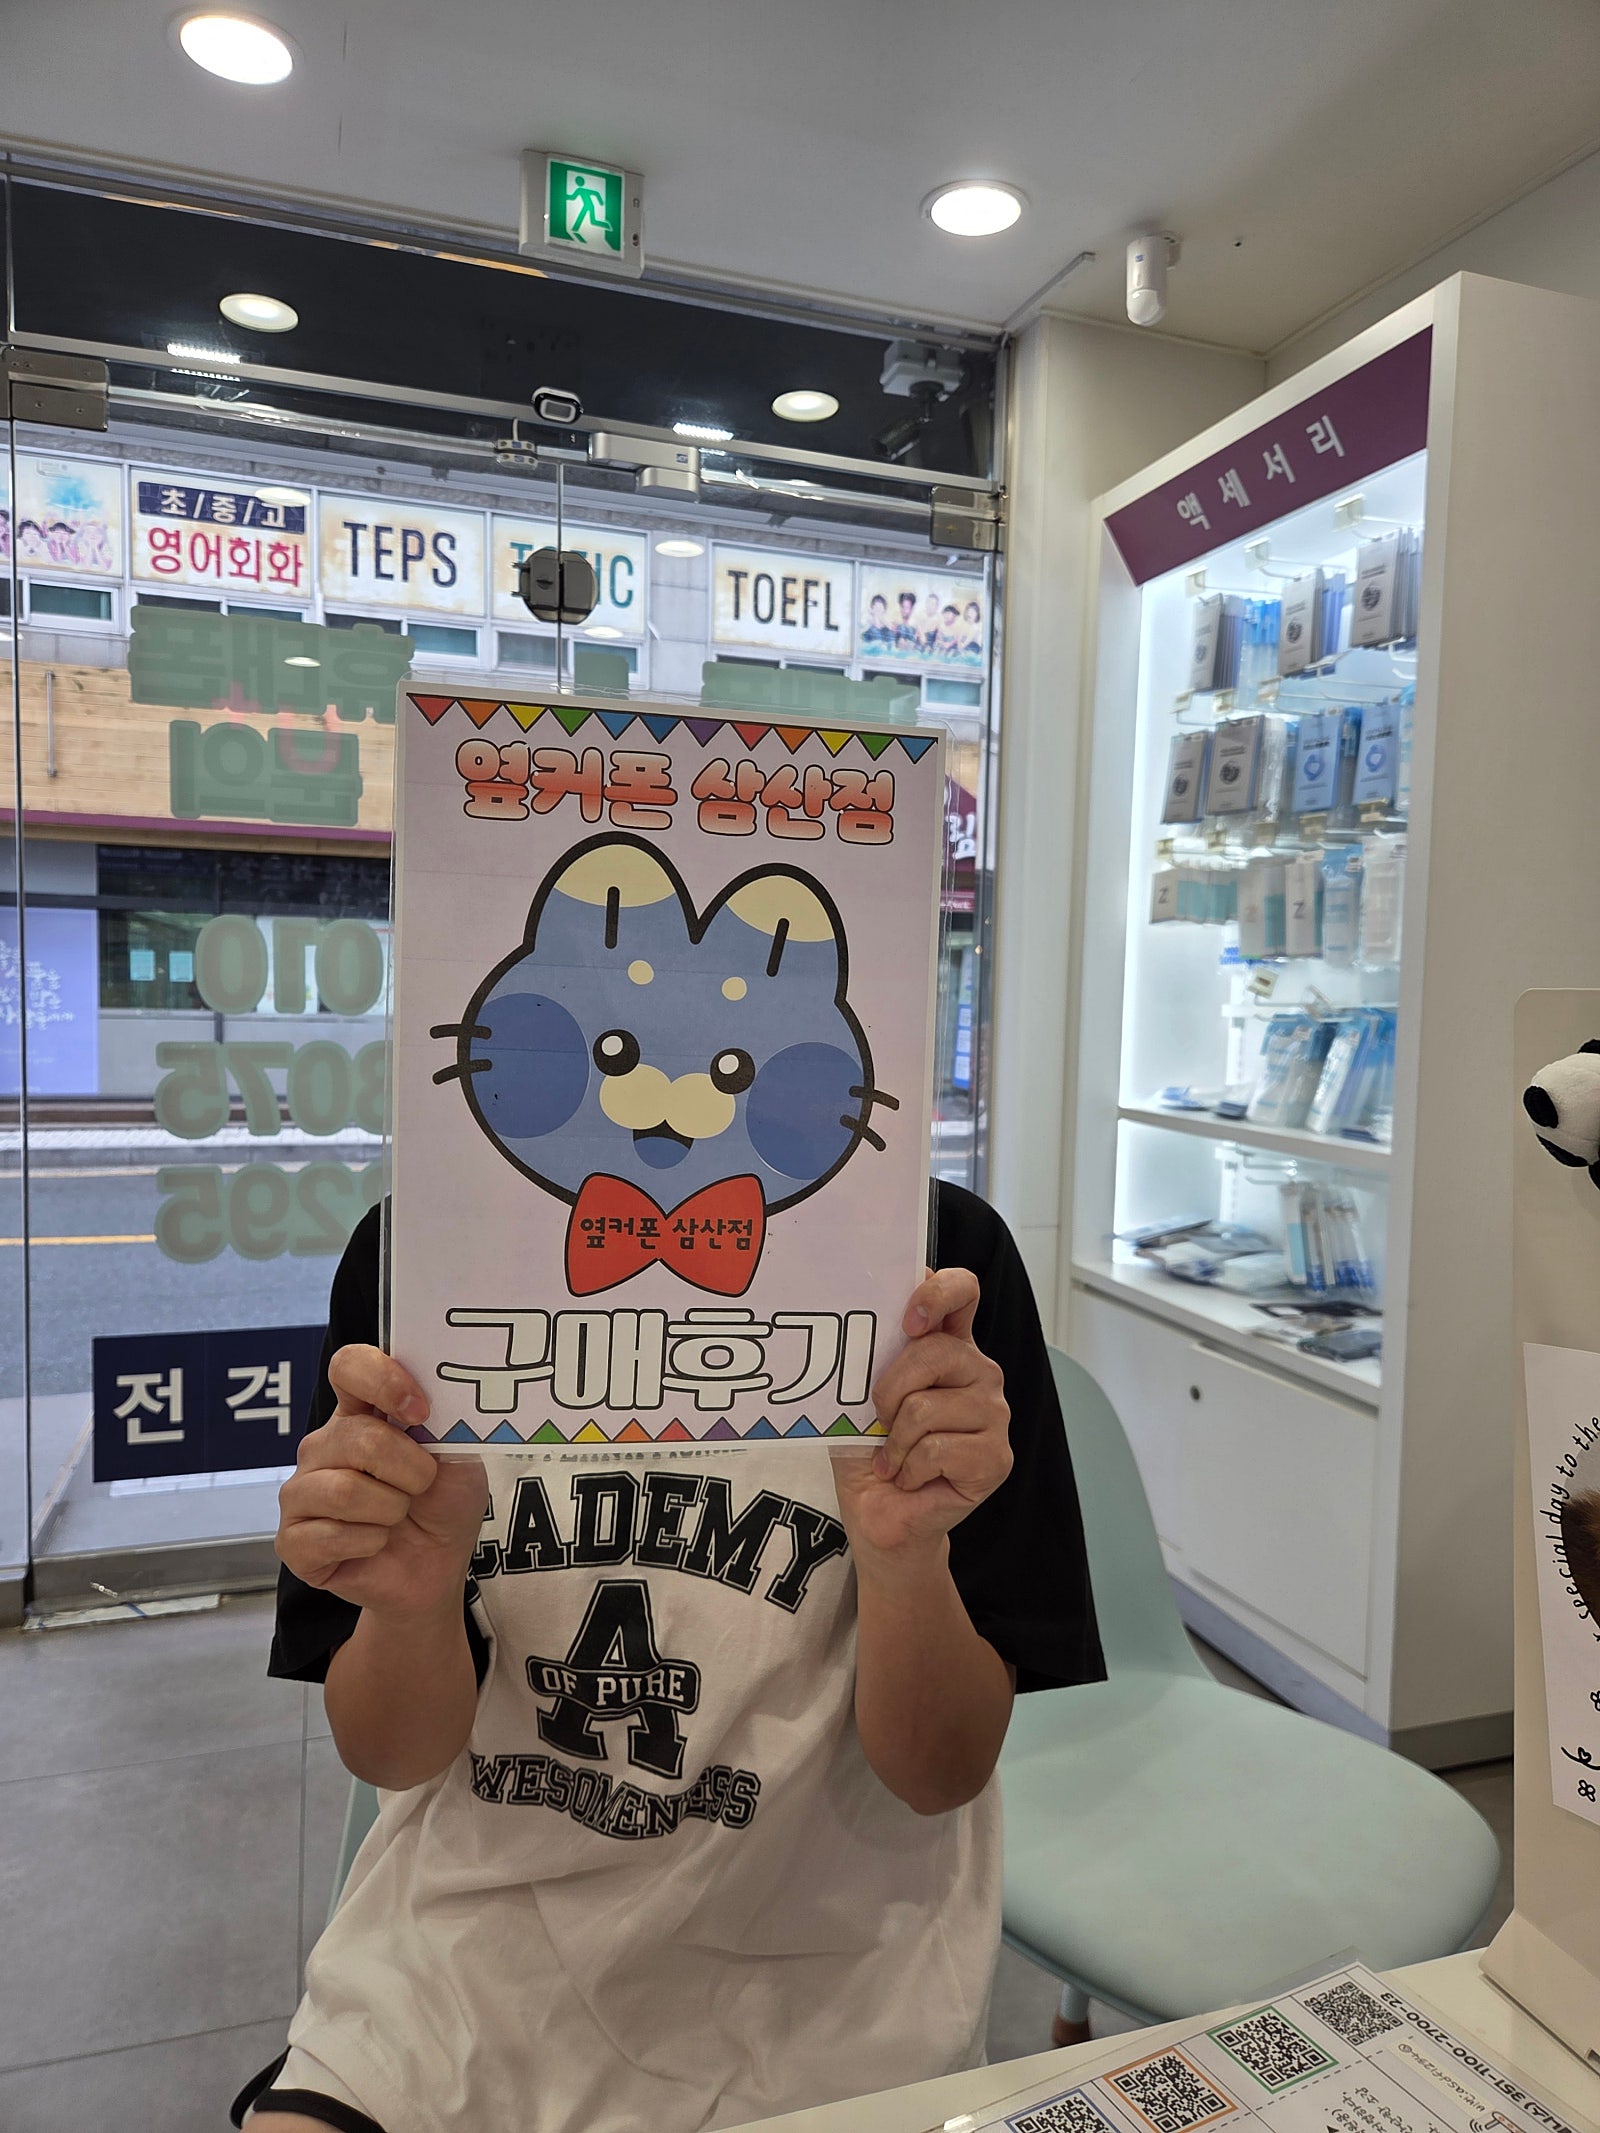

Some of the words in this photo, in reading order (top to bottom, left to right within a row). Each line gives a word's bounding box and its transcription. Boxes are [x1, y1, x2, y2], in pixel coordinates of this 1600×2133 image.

[1176, 415, 1345, 531] 액세서리
[148, 526, 304, 588] 영어회화
[343, 520, 458, 588] TEPS
[510, 541, 634, 609] TIC
[726, 569, 840, 632] TOEFL
[456, 738, 679, 831] 옆커폰
[690, 758, 896, 845] 삼산점
[580, 1217, 661, 1251] 옆커폰
[672, 1218, 754, 1251] 삼산점
[436, 1308, 877, 1414] 구매후기
[1539, 1483, 1571, 1525] day
[1555, 1453, 1578, 1478] to
[542, 1666, 578, 1697] OF
[596, 1667, 686, 1707] PURE
